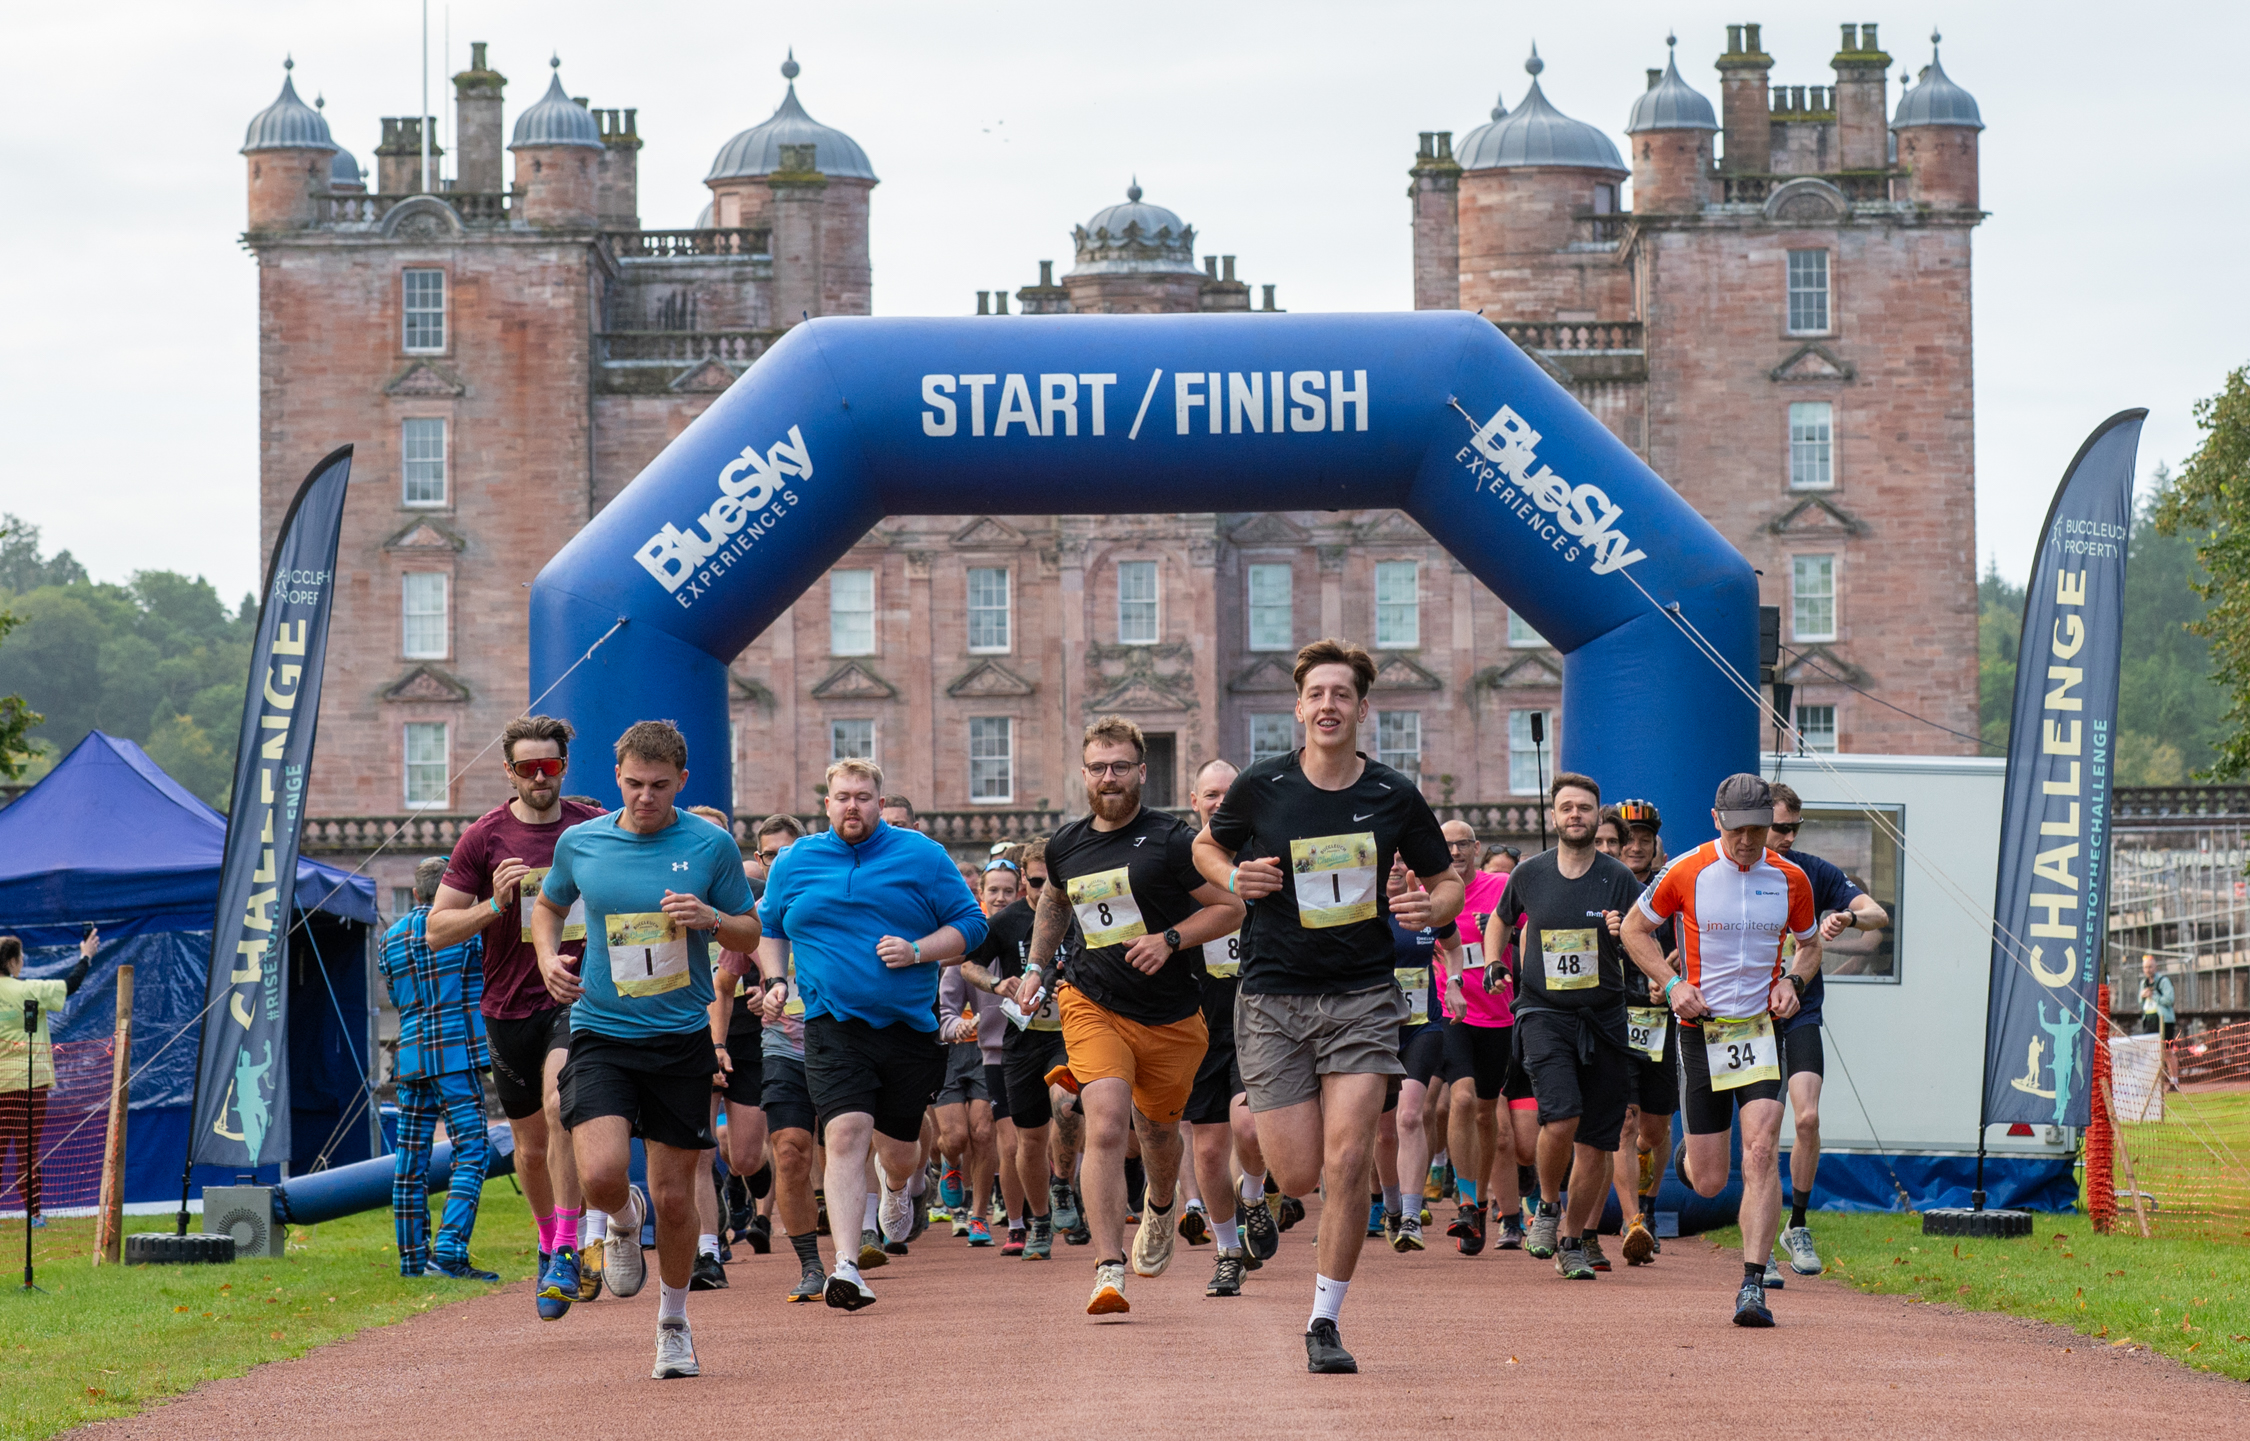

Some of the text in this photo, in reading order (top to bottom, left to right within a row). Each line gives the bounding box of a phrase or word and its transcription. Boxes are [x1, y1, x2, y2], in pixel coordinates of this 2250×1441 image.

[921, 368, 1368, 440] START / FINISH
[1455, 446, 1580, 563] EXPERIENCES
[676, 489, 799, 609] EXPERIENCES
[2064, 539, 2119, 559] PROPERTY
[2030, 569, 2087, 988] CHALLENGE
[1097, 902, 1114, 927] 8
[1706, 920, 1780, 933] jmarchitects
[1227, 938, 1241, 960] 8
[1557, 954, 1580, 975] 48
[1631, 1027, 1650, 1045] 98
[1727, 1042, 1756, 1070] 34
